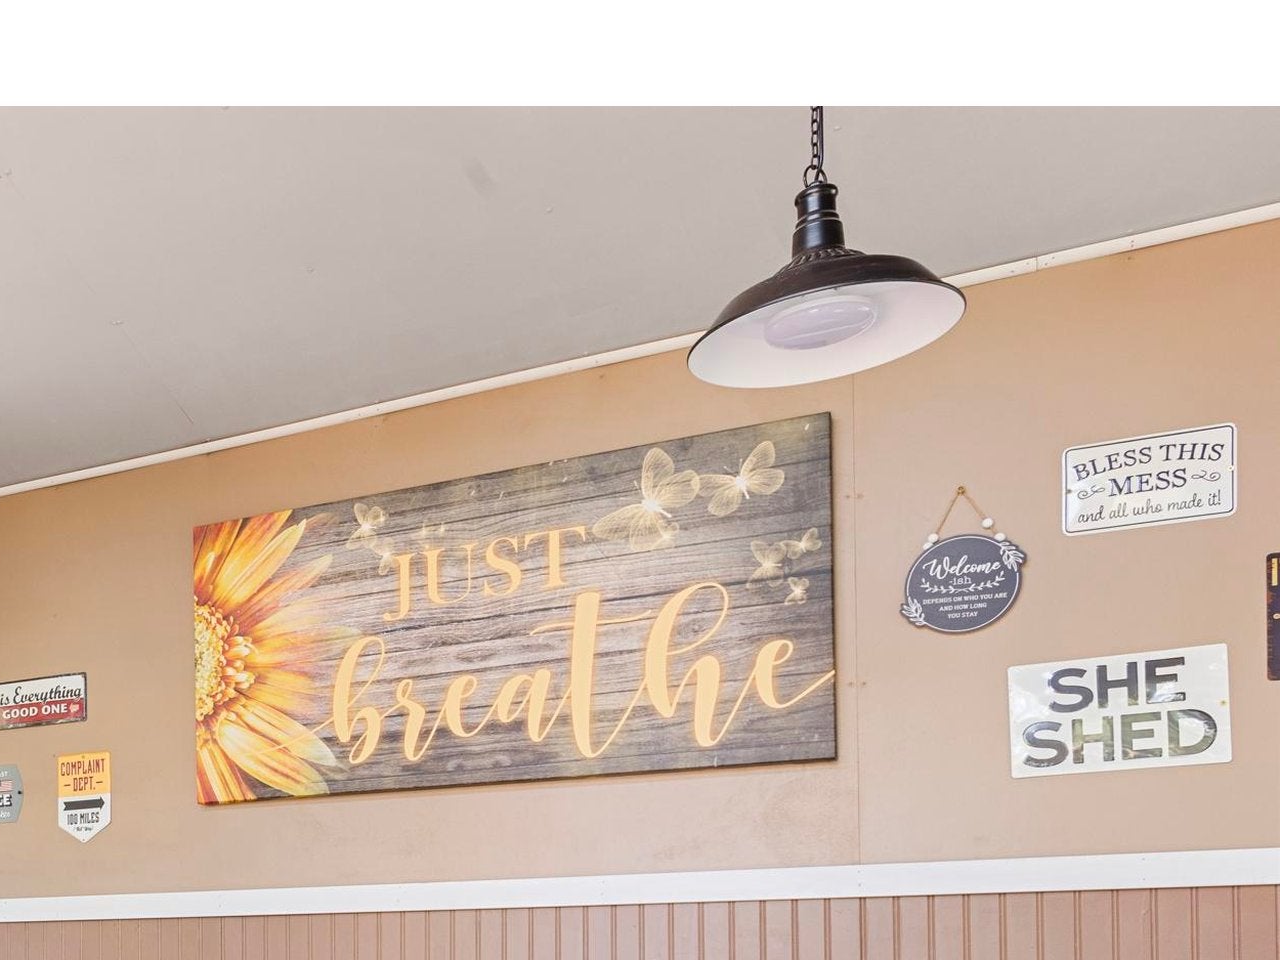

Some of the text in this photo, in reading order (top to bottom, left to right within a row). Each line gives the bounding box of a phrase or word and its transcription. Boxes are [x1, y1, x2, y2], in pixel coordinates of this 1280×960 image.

[1072, 442, 1225, 482] BLESS THIS
[1108, 467, 1188, 498] MESS
[1077, 489, 1222, 524] and all who made it!
[382, 524, 588, 623] JUST
[922, 555, 1001, 580] Welcome
[922, 596, 953, 605] DEPENDS
[265, 581, 835, 765] breathe
[1047, 656, 1187, 714] SHE
[0, 694, 10, 707] is
[12, 685, 82, 705] Everything
[2, 705, 38, 720] GOOD
[41, 702, 68, 715] ONE
[1022, 708, 1218, 769] SHED
[60, 758, 105, 776] COMPLAINT
[67, 811, 100, 826] 100 MILES
